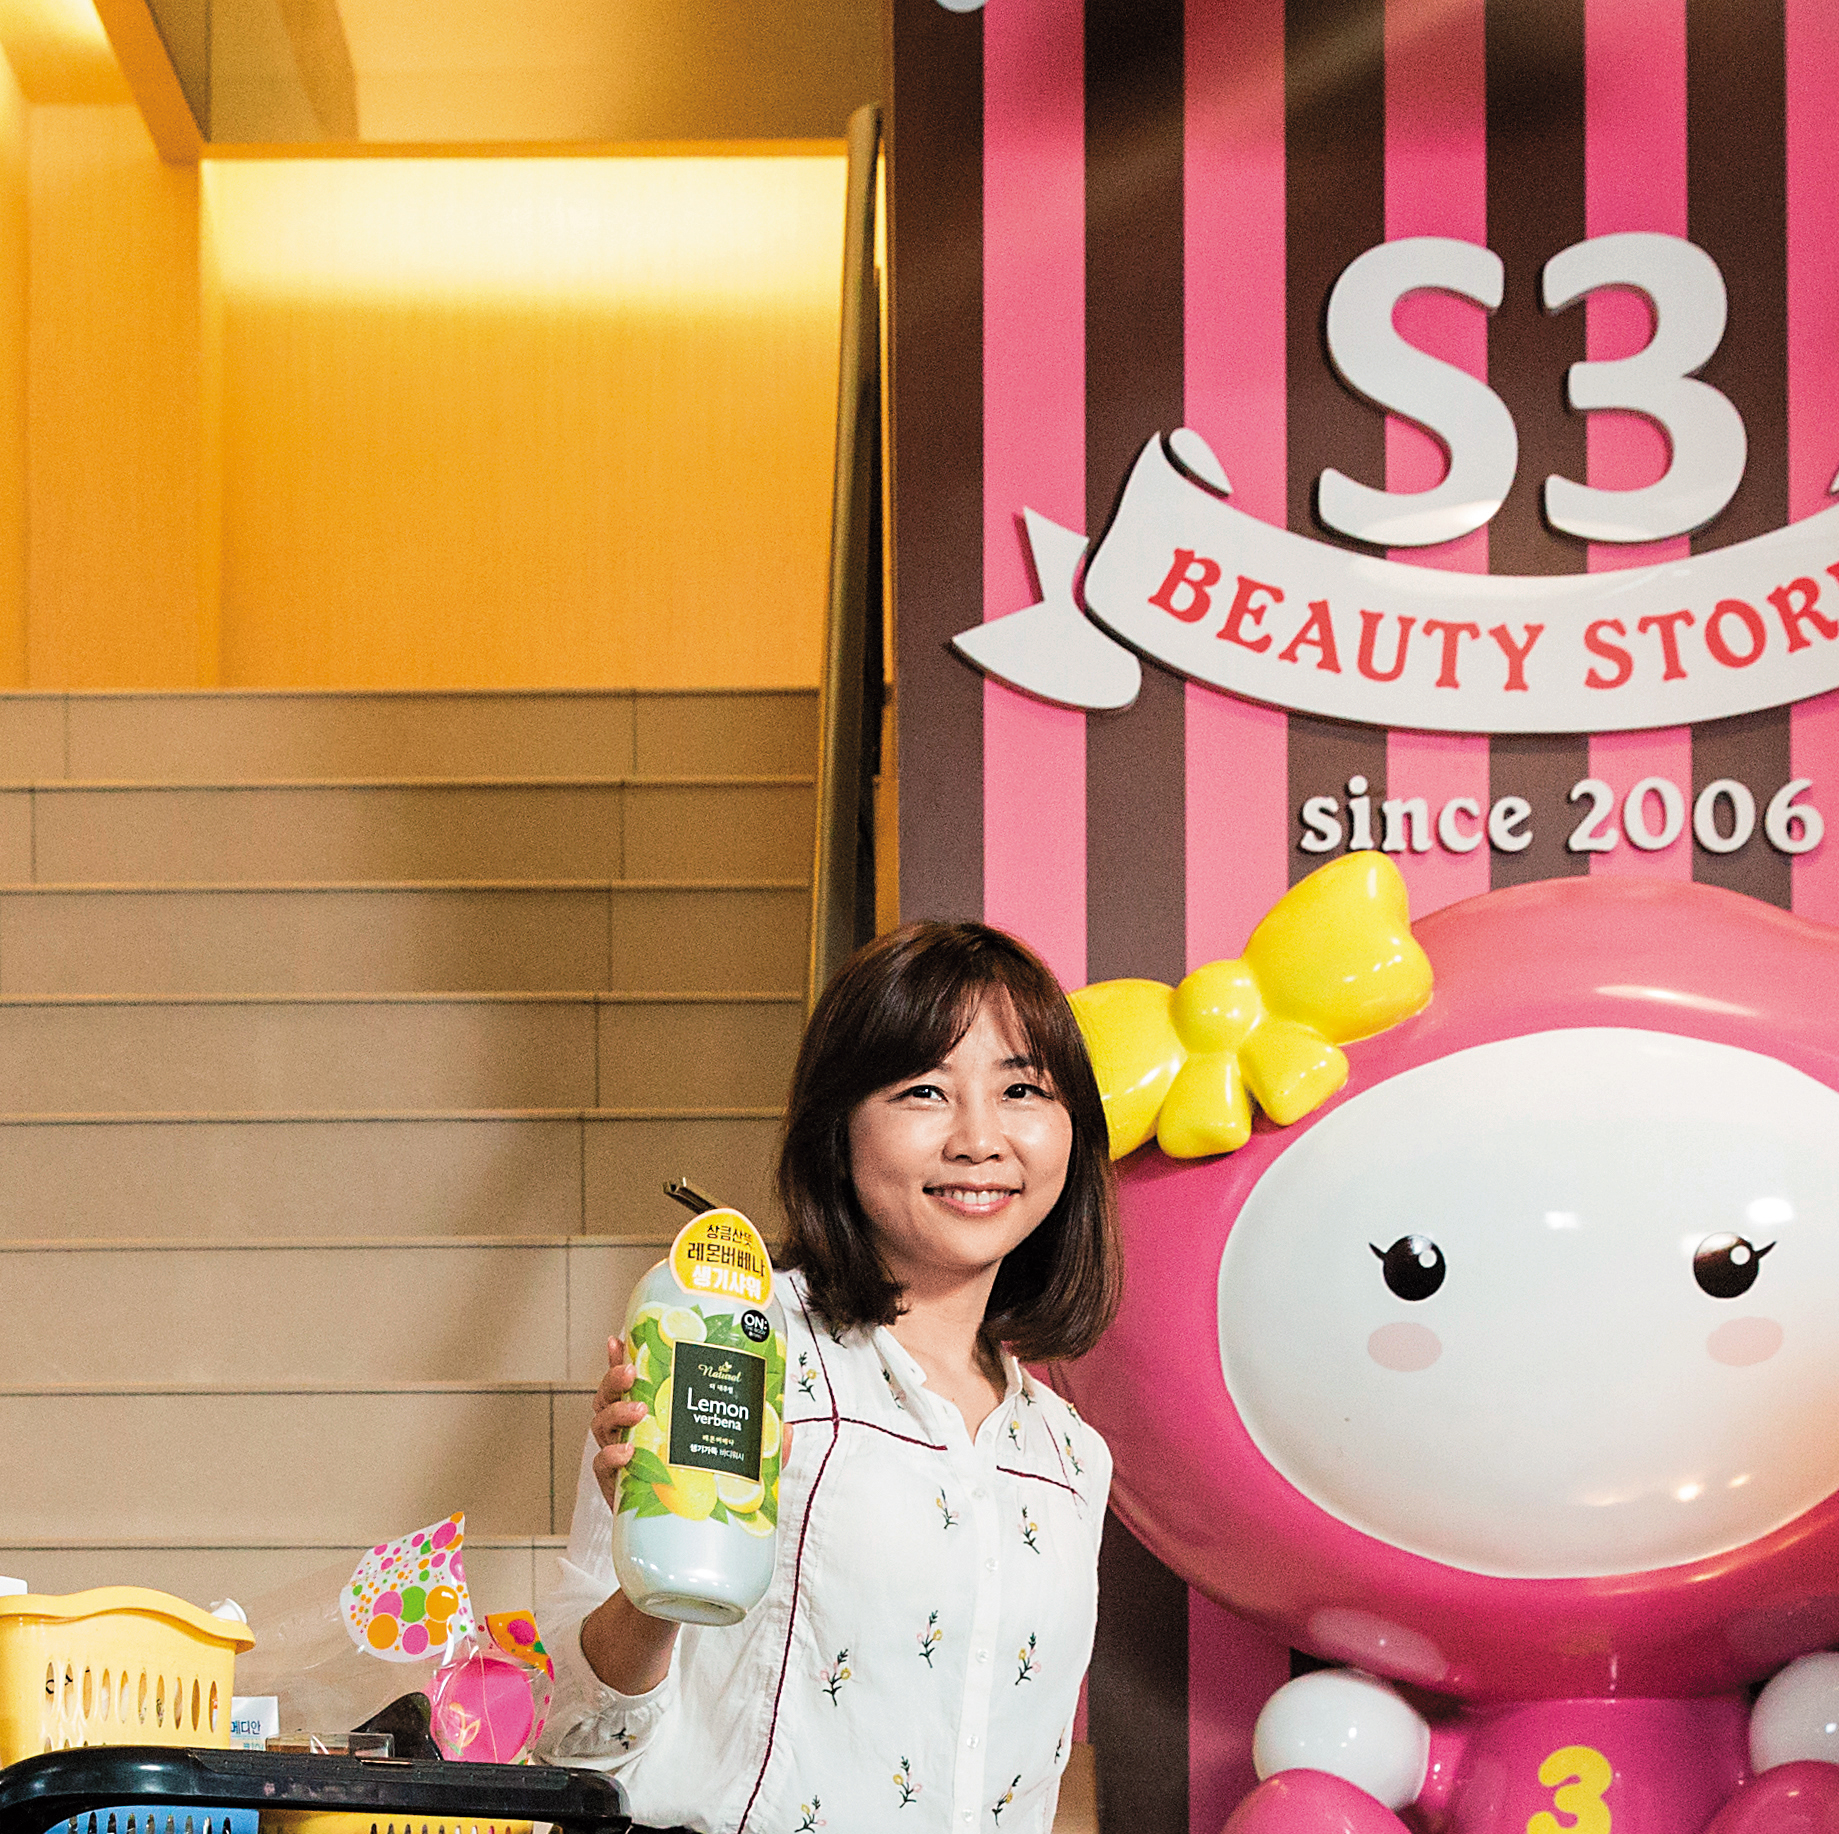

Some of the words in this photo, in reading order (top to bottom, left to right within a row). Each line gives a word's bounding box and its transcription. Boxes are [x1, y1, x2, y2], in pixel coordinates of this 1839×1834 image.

[1317, 230, 1748, 547] S3
[1148, 547, 1545, 694] BEAUTY
[1301, 775, 1534, 855] since
[1568, 778, 1826, 857] 2006
[687, 1242, 765, 1278] 레몬버베나
[744, 1313, 768, 1330] ON:
[698, 1363, 741, 1383] Natural
[687, 1387, 749, 1420] Lemon
[693, 1413, 742, 1431] verbena
